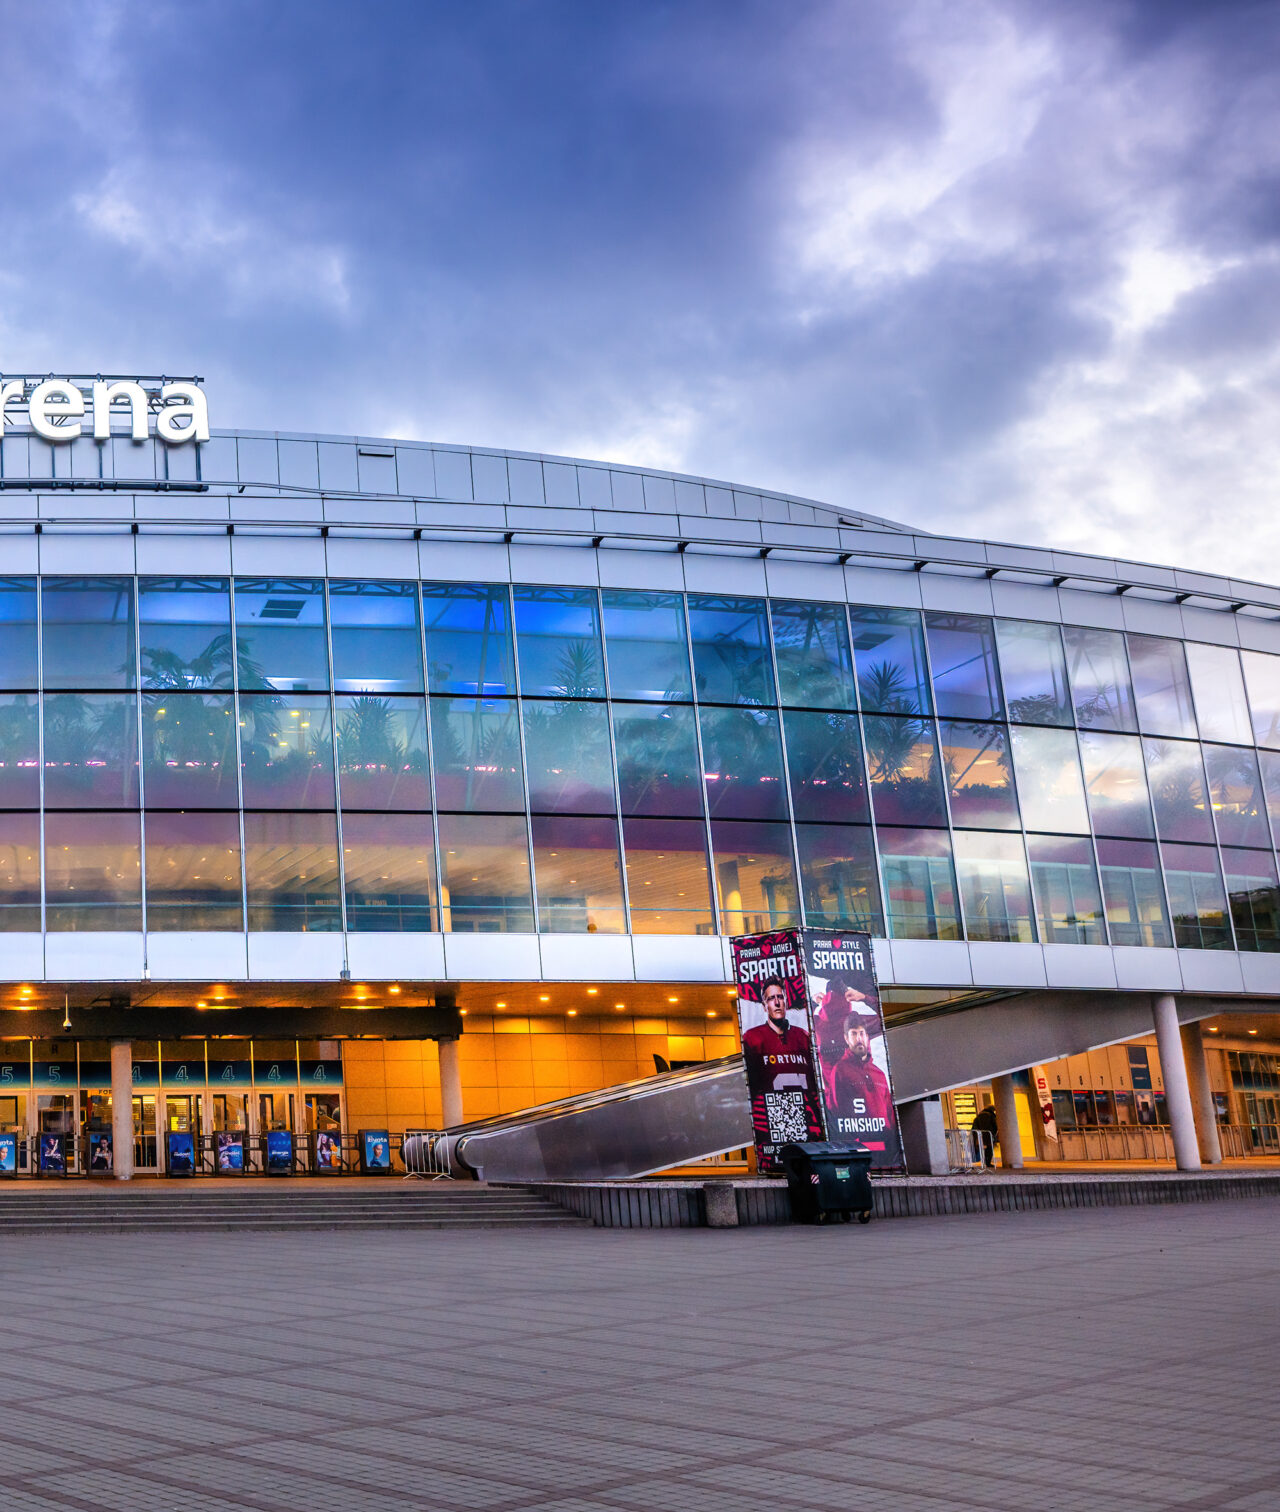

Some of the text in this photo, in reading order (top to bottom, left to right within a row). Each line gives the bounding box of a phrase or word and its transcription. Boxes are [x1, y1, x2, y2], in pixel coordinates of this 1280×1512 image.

[740, 947, 761, 959] PRAHA
[813, 940, 860, 950] PRAHA STYLE
[740, 954, 799, 983] SPARTA
[812, 951, 865, 970] SPARTA
[1, 1066, 14, 1084] 5
[48, 1065, 61, 1083] 5
[131, 1065, 143, 1082] 4
[176, 1065, 189, 1081] 4
[221, 1064, 235, 1081] 4
[268, 1064, 281, 1081] 4
[314, 1064, 327, 1081] 4
[1037, 1077, 1047, 1089] S
[853, 1098, 866, 1114] S
[837, 1117, 886, 1133] FANSHOP
